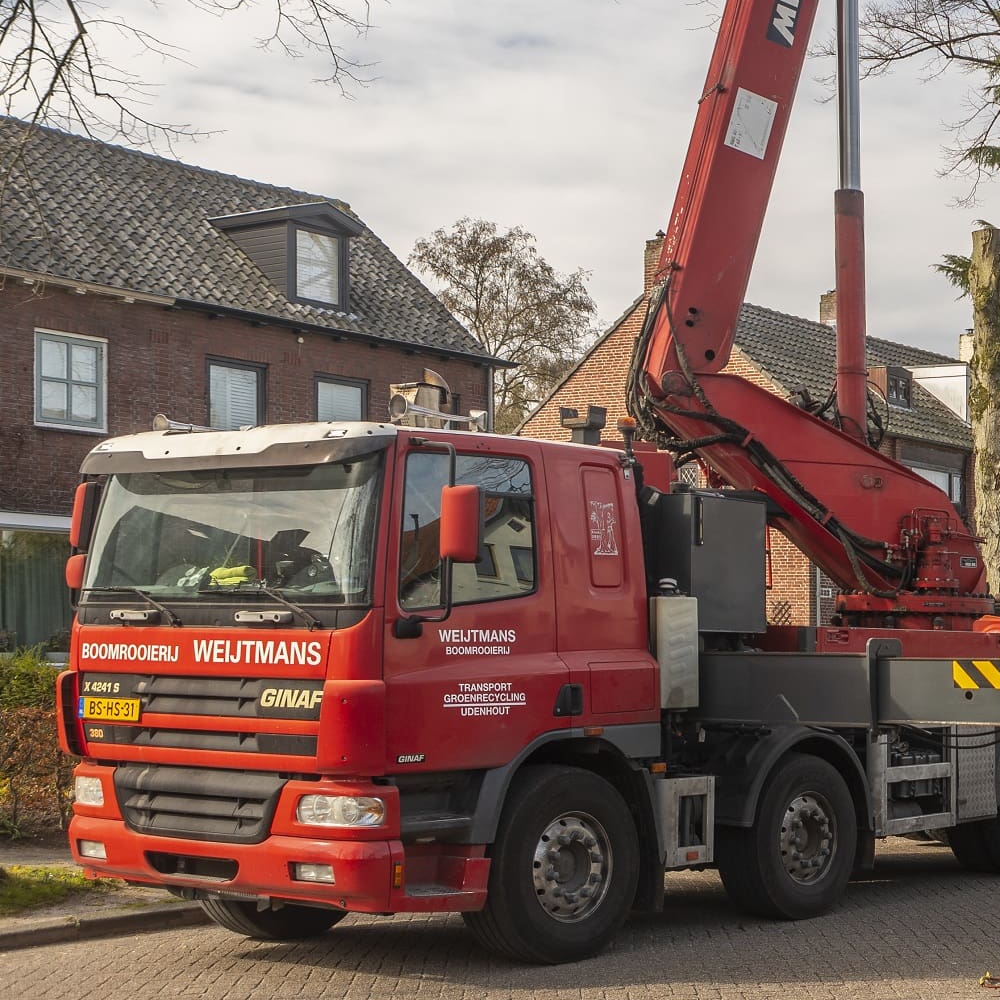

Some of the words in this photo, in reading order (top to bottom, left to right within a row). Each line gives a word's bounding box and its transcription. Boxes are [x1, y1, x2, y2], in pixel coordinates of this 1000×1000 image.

[438, 629, 516, 643] WEIJTMANS
[81, 642, 180, 662] BOOMROOIERIJ
[193, 639, 322, 666] WEIJTMANS
[445, 646, 510, 655] BOOMROOIERIJ
[83, 681, 91, 692] X
[91, 681, 112, 693] 4241
[113, 682, 120, 693] S
[459, 683, 513, 692] TRANSPORT
[260, 688, 324, 709] GINAF
[443, 692, 526, 703] GROENRECYCLING
[89, 701, 135, 718] BS-HS-31
[460, 706, 511, 716] UDENHOUT
[89, 728, 104, 739] 380
[398, 754, 425, 763] GINAF
